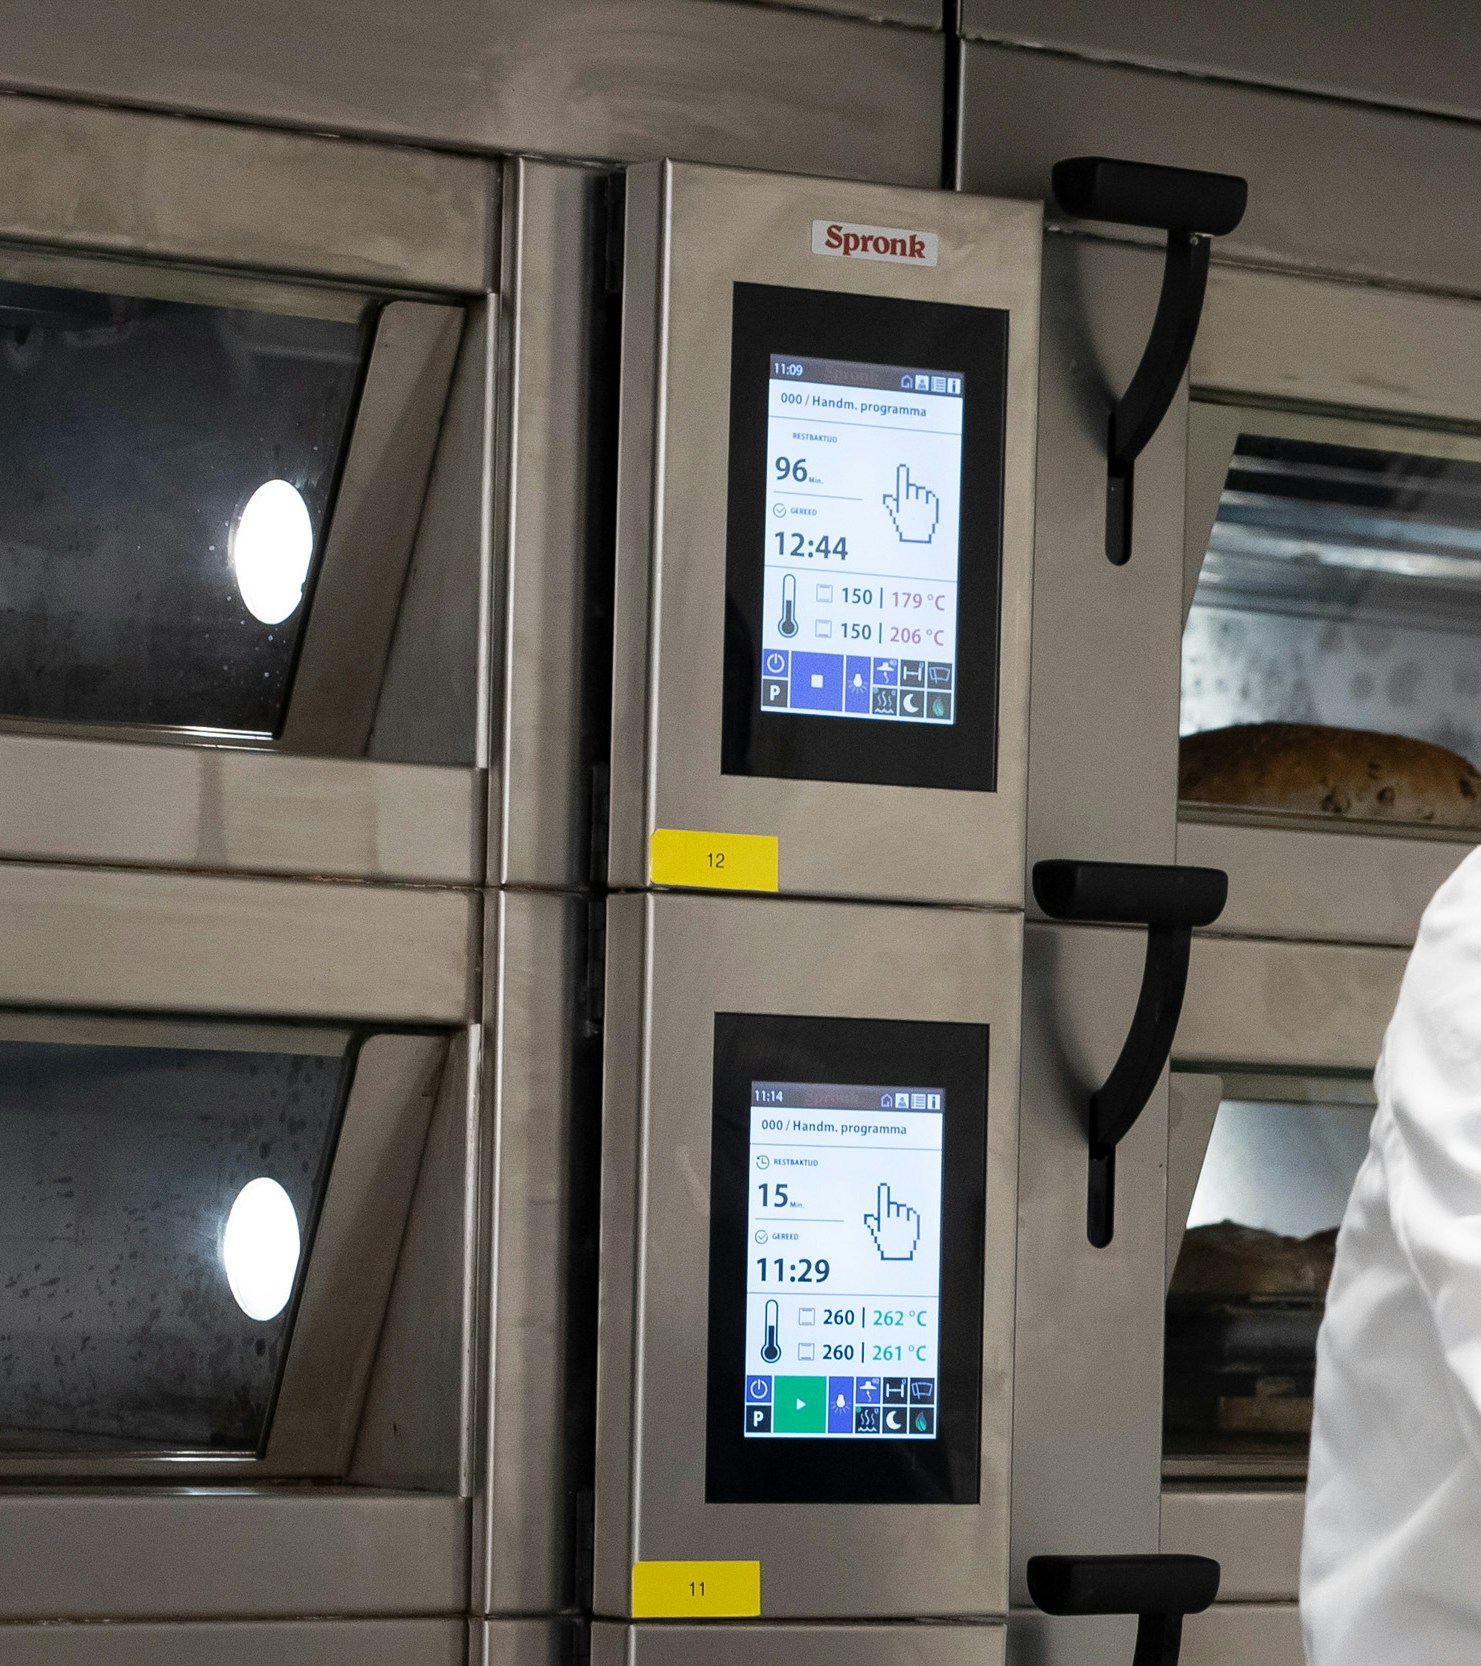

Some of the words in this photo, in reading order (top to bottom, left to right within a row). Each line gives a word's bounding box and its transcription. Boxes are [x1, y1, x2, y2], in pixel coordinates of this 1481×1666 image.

[825, 224, 926, 258] Spronk
[773, 362, 803, 376] 11:09
[781, 392, 802, 405] 000
[812, 396, 858, 410] Handm.
[860, 402, 927, 417] programma
[775, 456, 808, 482] 96
[808, 476, 824, 484] Min.
[790, 507, 817, 516] GEREED
[774, 531, 848, 560] 12:44
[842, 587, 872, 604] 150
[892, 592, 922, 608] 179
[927, 594, 945, 611] °C
[841, 622, 872, 640] 150
[890, 627, 921, 644] 206
[926, 629, 944, 646] °C
[707, 853, 725, 868] 12
[754, 1090, 783, 1103] 11:14
[761, 1119, 783, 1131] 000
[793, 1120, 838, 1133] Handm.
[841, 1123, 907, 1136] programma
[758, 1183, 789, 1208] 15
[772, 1233, 799, 1241] GEREED
[757, 1258, 830, 1283] 11:29
[823, 1309, 855, 1325] 260
[873, 1310, 904, 1326] 262
[909, 1310, 927, 1327] °C
[822, 1344, 854, 1360] 260
[872, 1346, 901, 1361] 261
[908, 1345, 926, 1361] °C
[689, 1581, 705, 1596] 11
